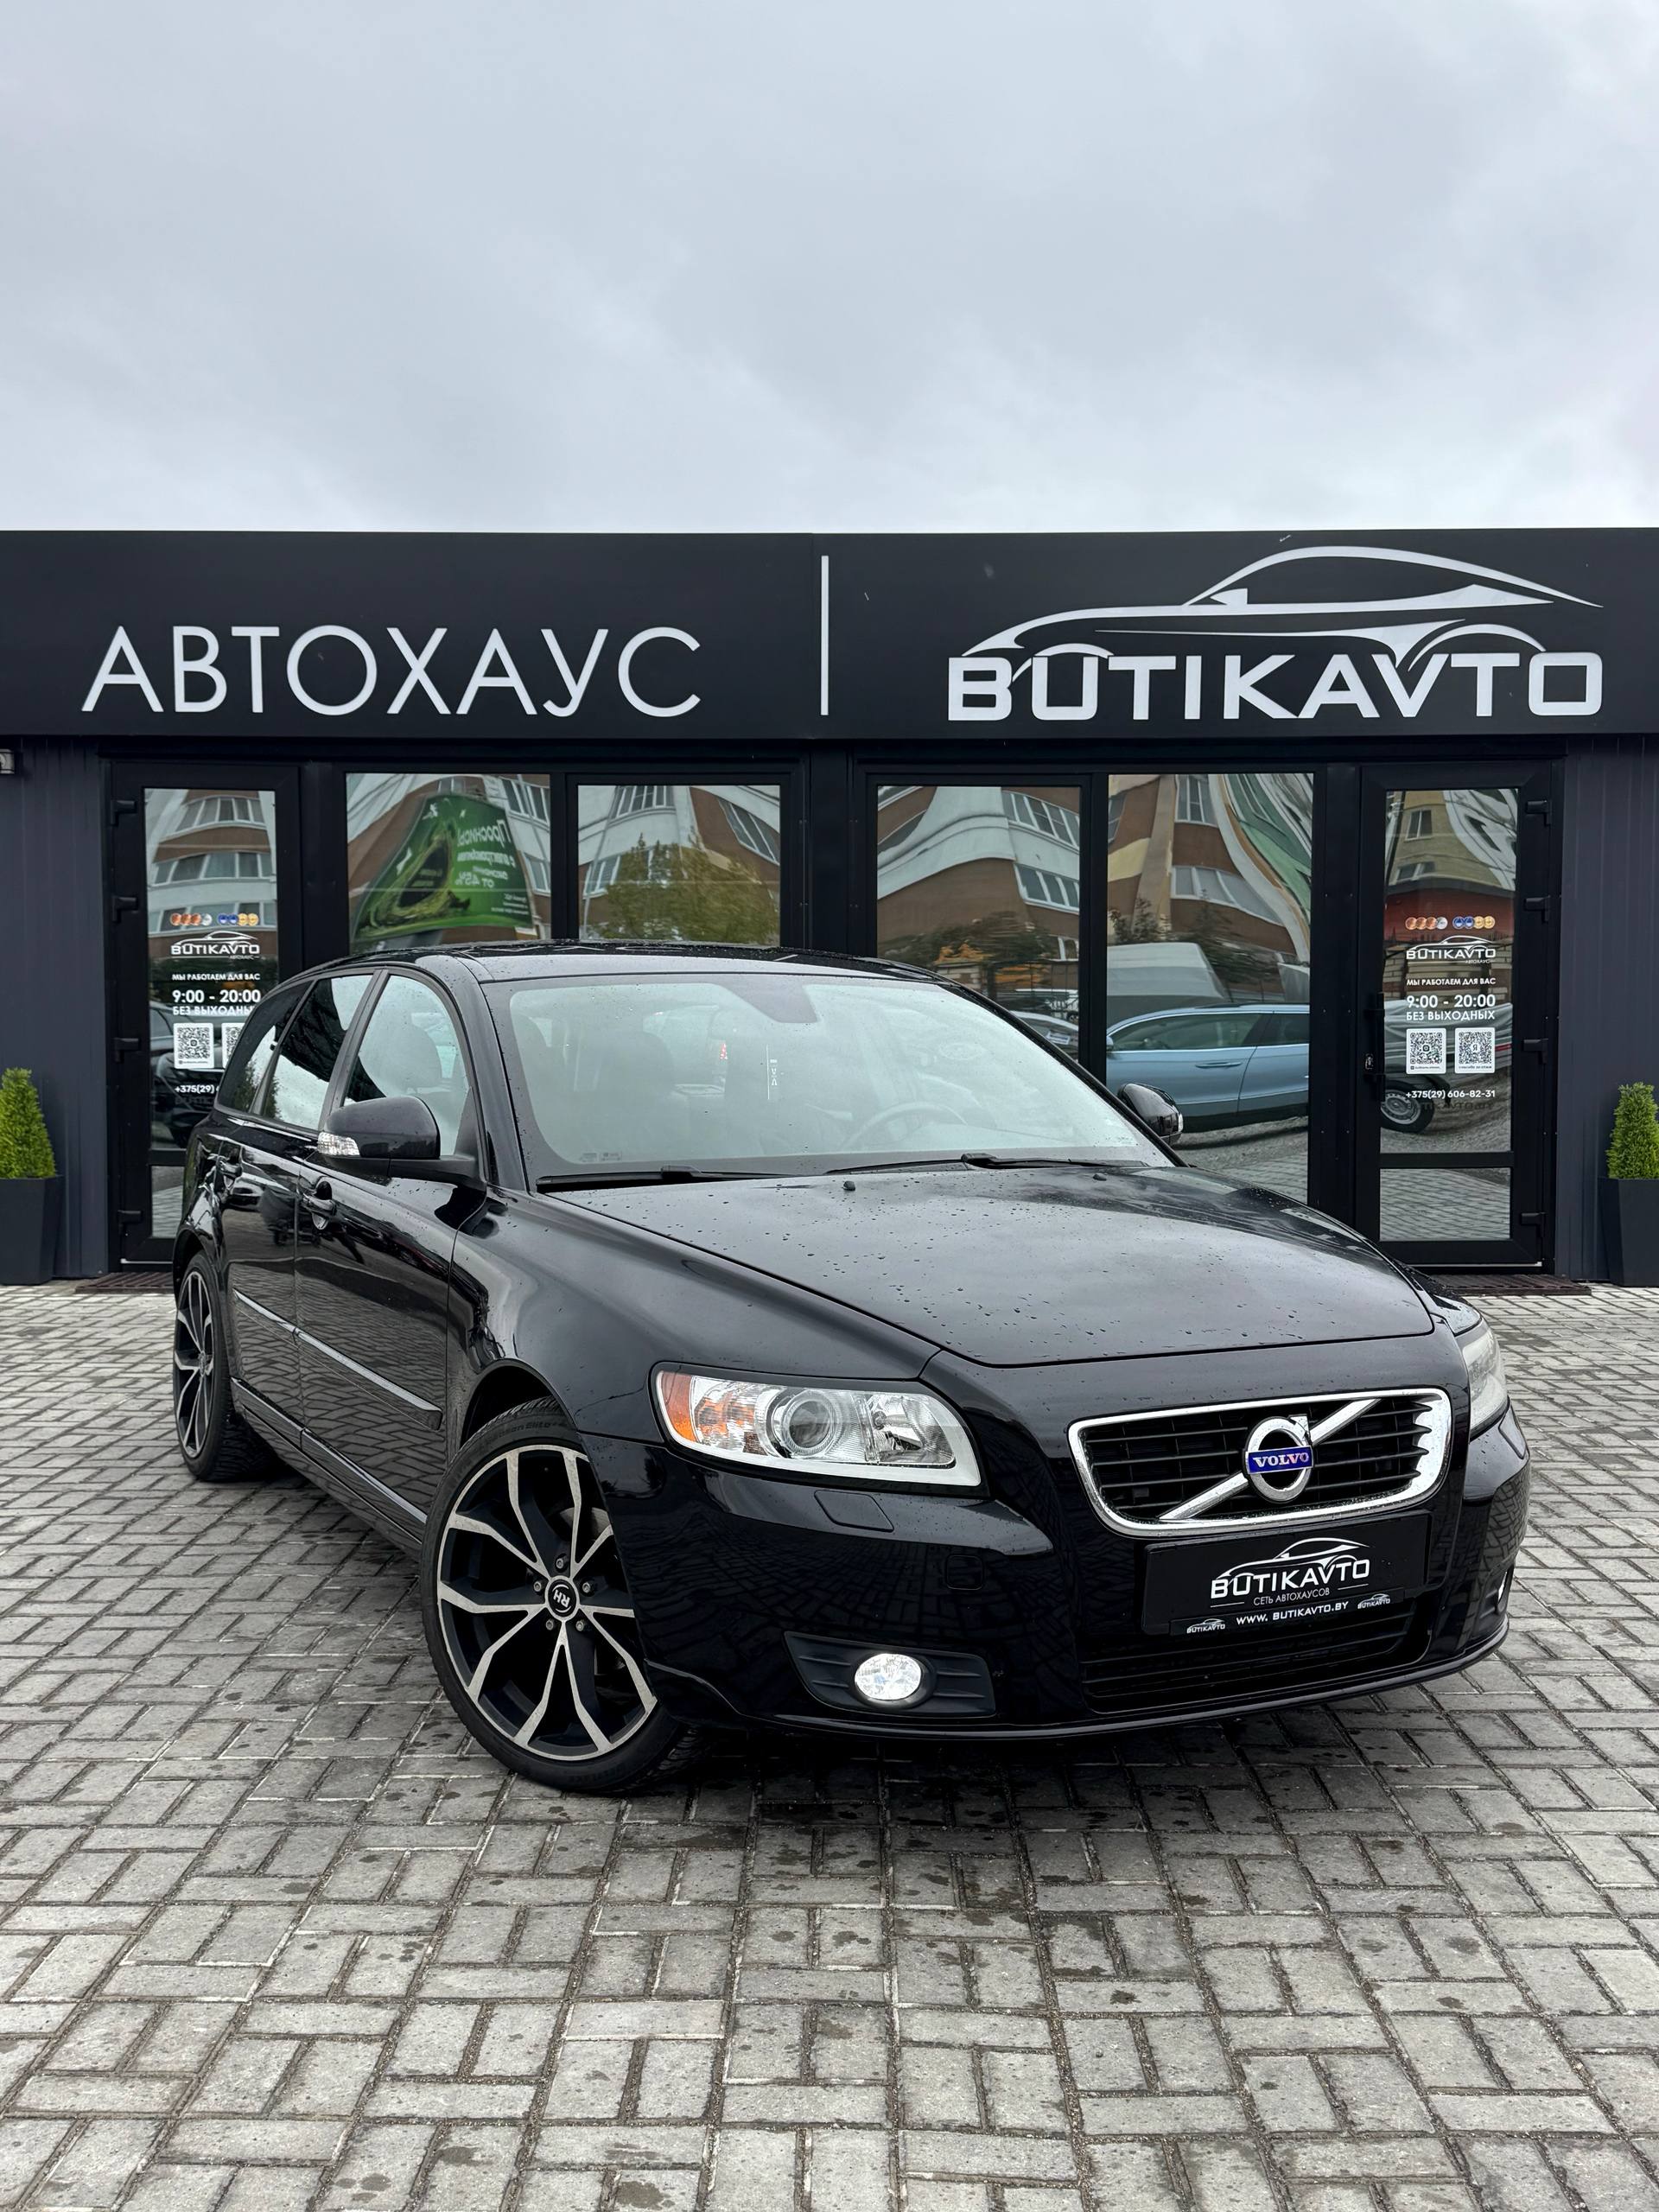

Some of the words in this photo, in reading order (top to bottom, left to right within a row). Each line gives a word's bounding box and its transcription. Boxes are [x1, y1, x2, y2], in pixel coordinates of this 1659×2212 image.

[82, 626, 701, 717] АВТОХАУС
[948, 652, 1603, 721] BUTIKAVTO
[170, 944, 260, 955] BUTIKAVTO
[1406, 948, 1496, 960] BUTIKAVTO
[172, 990, 205, 1003] 9:00
[219, 989, 261, 1003] 20:00
[1407, 995, 1439, 1008] 9:00
[1453, 995, 1496, 1007] 20:00
[173, 1006, 191, 1016] БЕЗ
[193, 1005, 256, 1016] ВЫХОДНЫ
[1407, 1012, 1425, 1021] БЕЗ
[1427, 1010, 1496, 1021] ВЫХОДНЫХ
[175, 1084, 215, 1094] +375(29)
[1406, 1090, 1446, 1100] +375(29)
[1447, 1090, 1496, 1099] 606-82-31
[1252, 1452, 1310, 1467] VOLVO
[1210, 1559, 1370, 1599] BUTIKAVTO
[553, 1589, 570, 1608] RH
[1253, 1596, 1274, 1605] СЕТЬ
[1275, 1587, 1331, 1603] АВТОХАУСОВ
[1186, 1623, 1226, 1633] BUTIKAVTO
[1236, 1613, 1268, 1625] WWW.
[1272, 1601, 1349, 1621] BUTIKAVTO.BY
[1357, 1597, 1391, 1609] BUTIKAVTO
